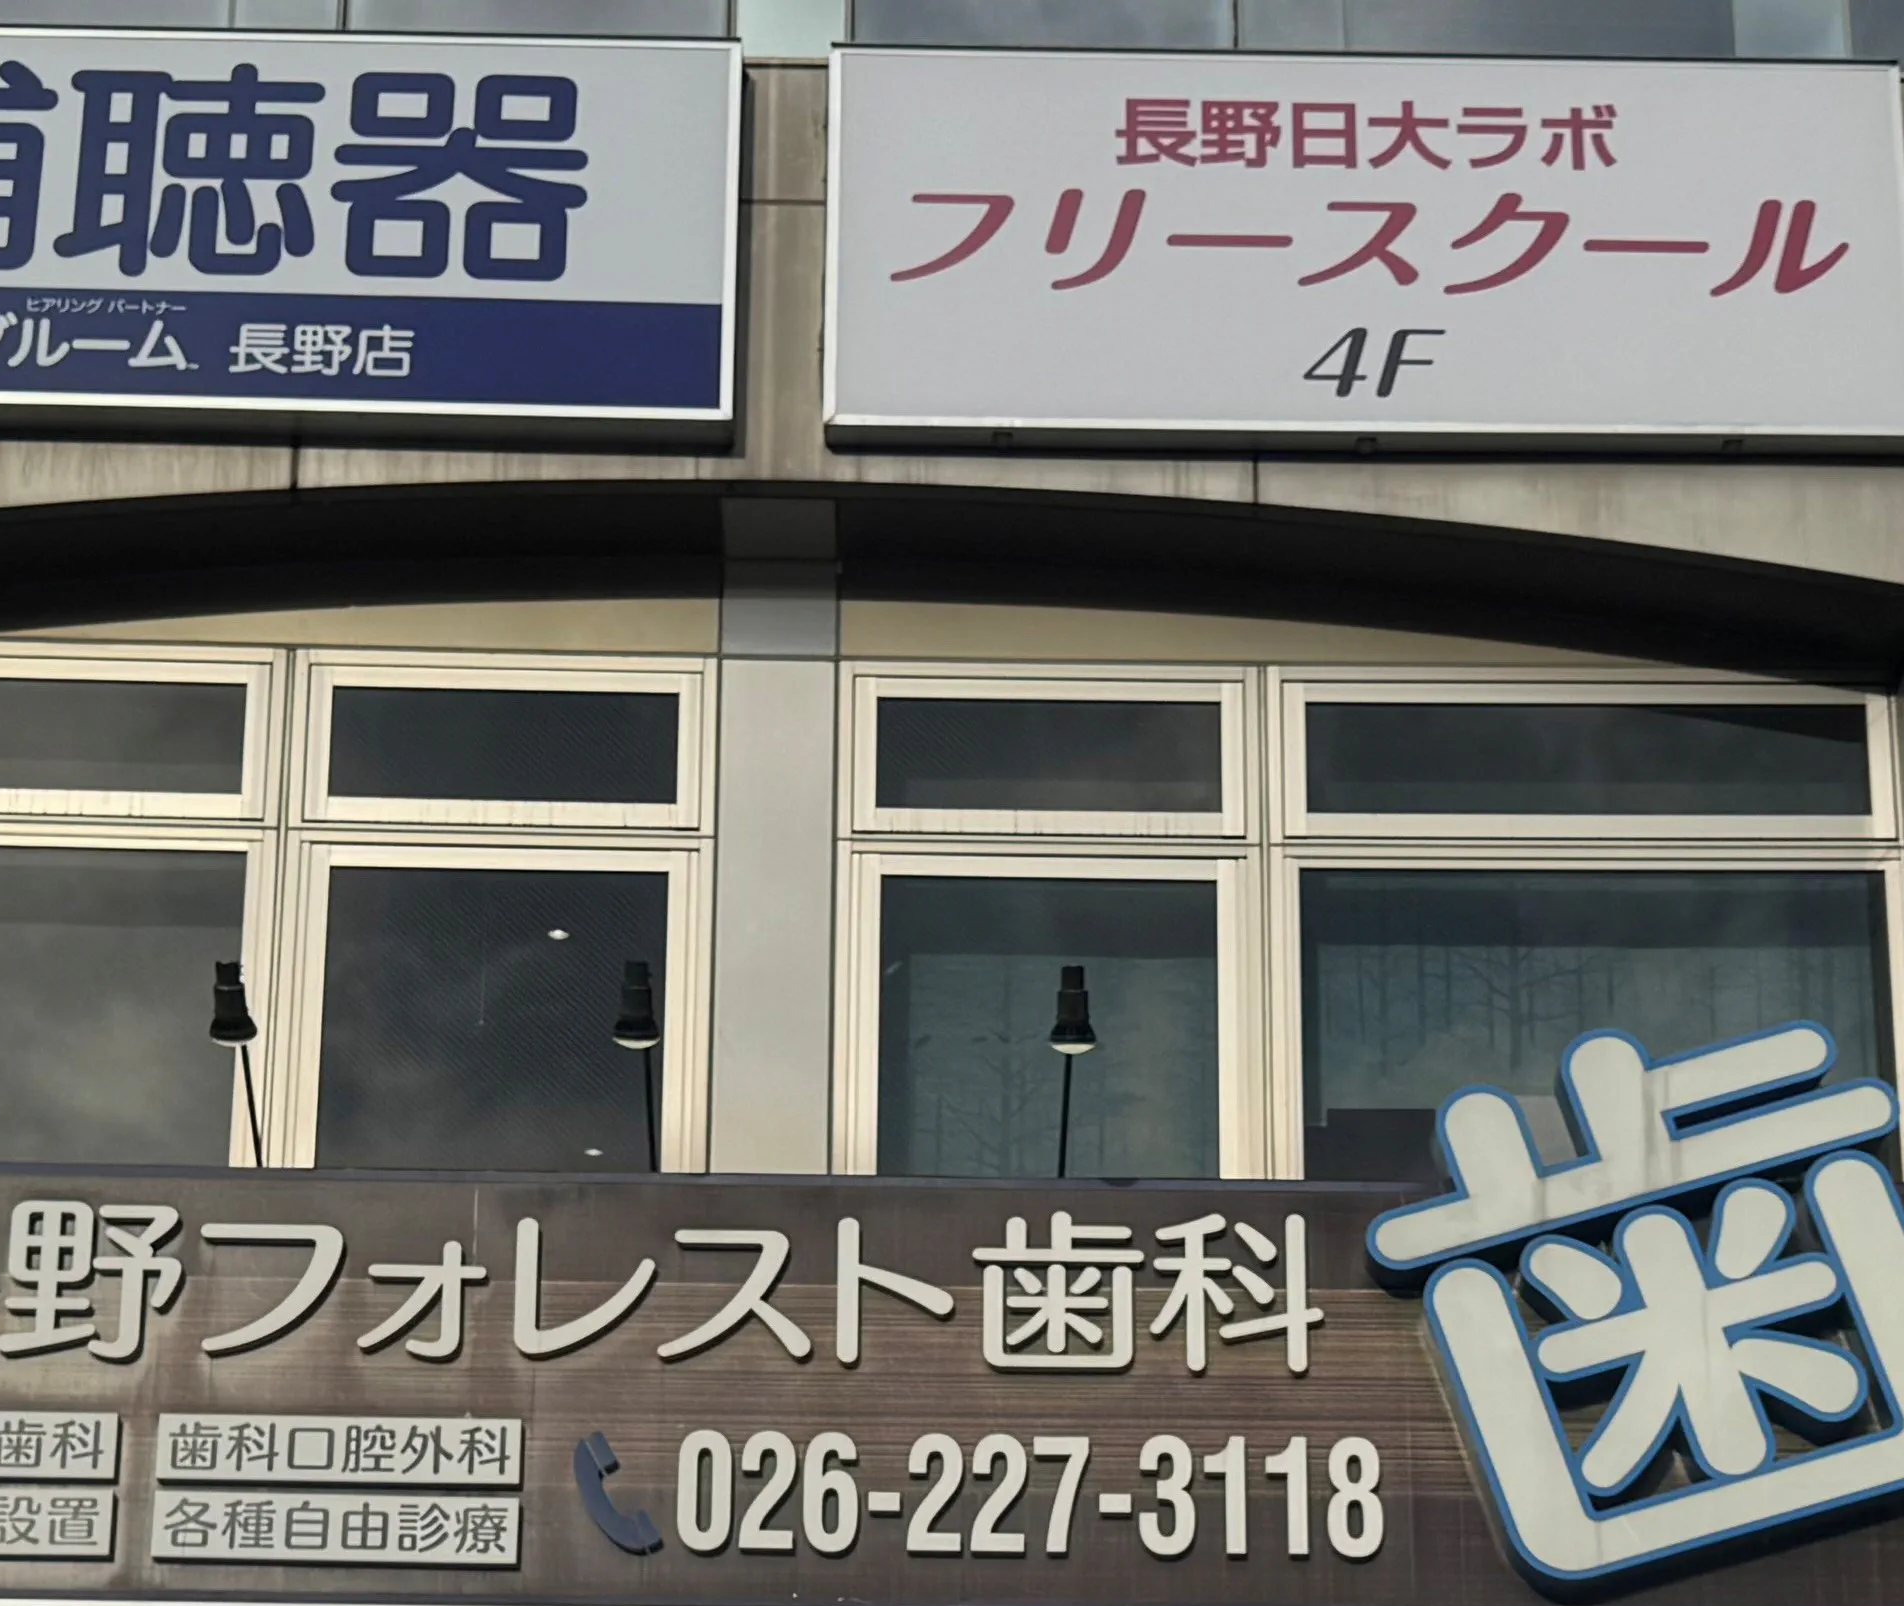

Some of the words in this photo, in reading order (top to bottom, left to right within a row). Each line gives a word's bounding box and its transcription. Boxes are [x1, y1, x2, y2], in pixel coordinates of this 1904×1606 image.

[1114, 96, 1619, 171] 長野日大ラボ
[889, 187, 1851, 297] フリースクール
[26, 297, 103, 314] ヒアリング
[108, 301, 187, 315] パートナー
[227, 322, 416, 377] 長野店
[1302, 326, 1447, 398] 4F
[167, 1421, 513, 1478] 歯科口腔外科
[162, 1497, 512, 1555] 各種自由診療
[674, 1428, 1386, 1560] 026-227-3118
